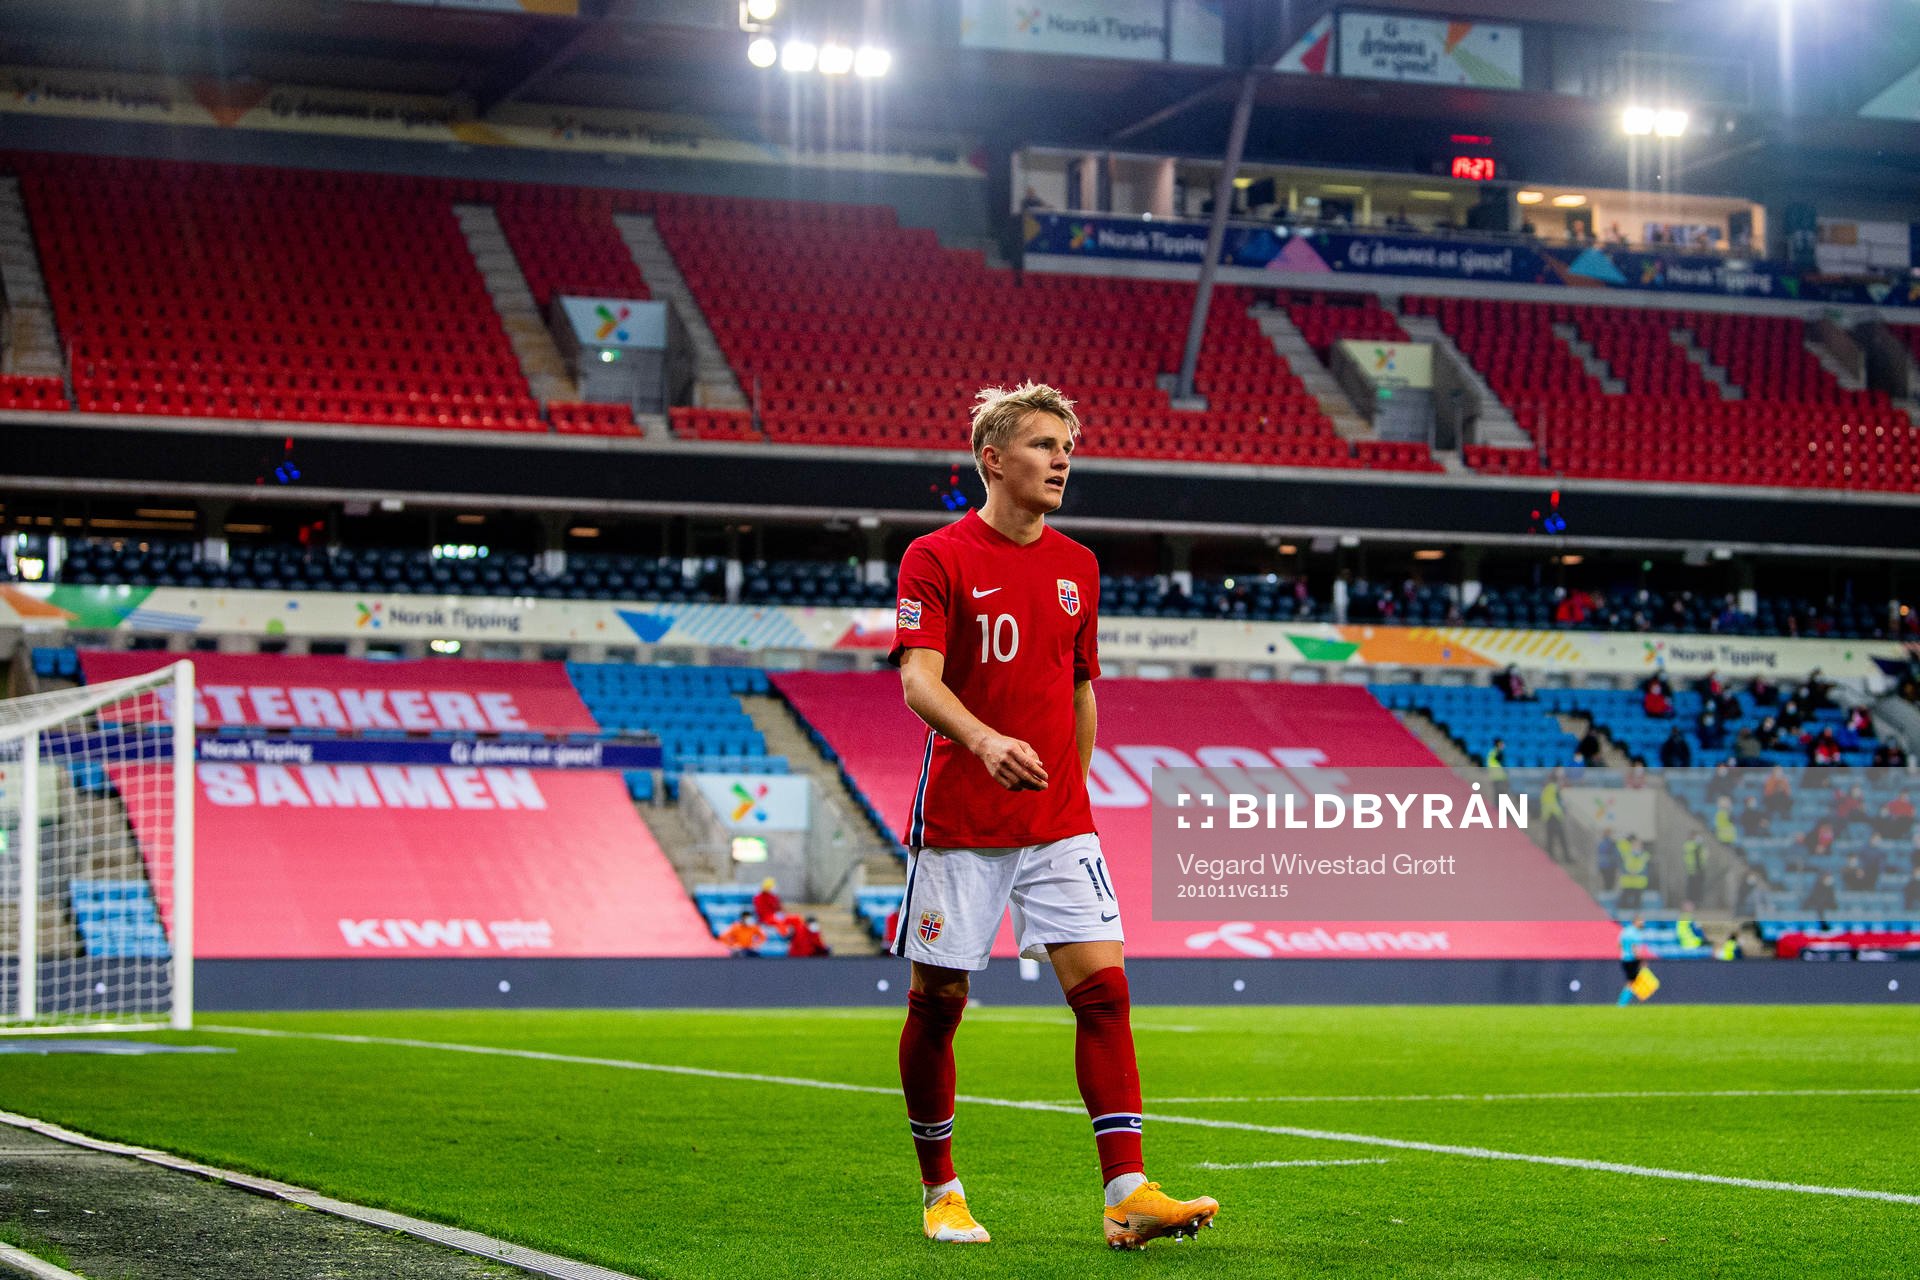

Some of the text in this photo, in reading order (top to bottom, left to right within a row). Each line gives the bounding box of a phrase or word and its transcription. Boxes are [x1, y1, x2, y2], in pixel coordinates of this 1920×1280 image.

[1099, 230, 1149, 248] Norsk
[389, 607, 521, 632] Norsk Tipping
[976, 613, 1019, 663] 10
[1669, 646, 1777, 668] Norsk Tipping
[158, 685, 528, 730] STERKERE
[202, 740, 313, 764] Norsk Tipping
[202, 764, 548, 810] SAMMEN
[338, 919, 490, 947] KIWI
[1263, 927, 1451, 952] telenor
